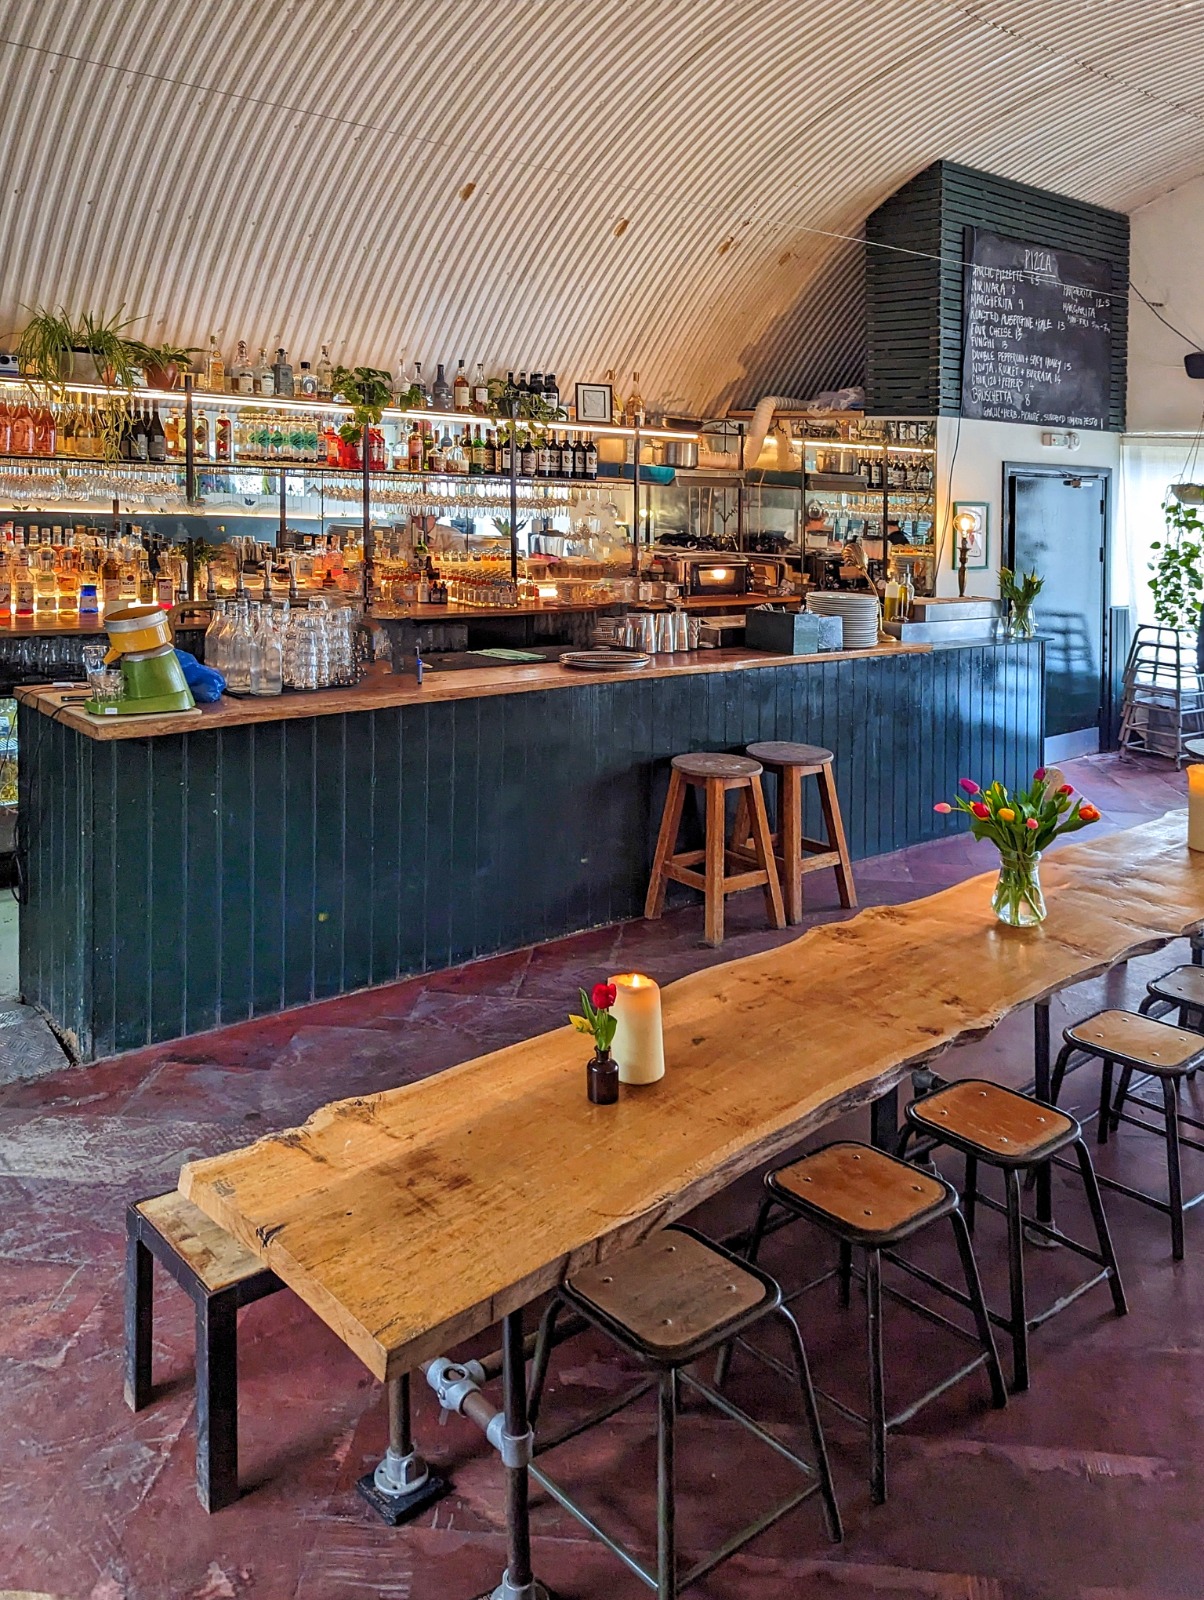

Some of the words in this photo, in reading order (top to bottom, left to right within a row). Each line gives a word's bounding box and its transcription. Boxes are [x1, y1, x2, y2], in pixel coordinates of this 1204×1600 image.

[1025, 249, 1052, 273] PIZZA
[971, 279, 1006, 296] MARINARA
[970, 292, 1013, 311] MARGHERITA
[1018, 298, 1024, 311] 9
[970, 307, 999, 323] ROASTED
[1057, 320, 1066, 331] 13
[970, 322, 987, 339] FOUR
[989, 325, 1013, 339] CHEESE
[970, 337, 995, 349] FUNGHI
[971, 349, 996, 362] DOUBLE
[971, 373, 997, 388] CHORIZO
[971, 387, 1013, 405] BRUSCHETTA
[1024, 393, 1031, 407] 8
